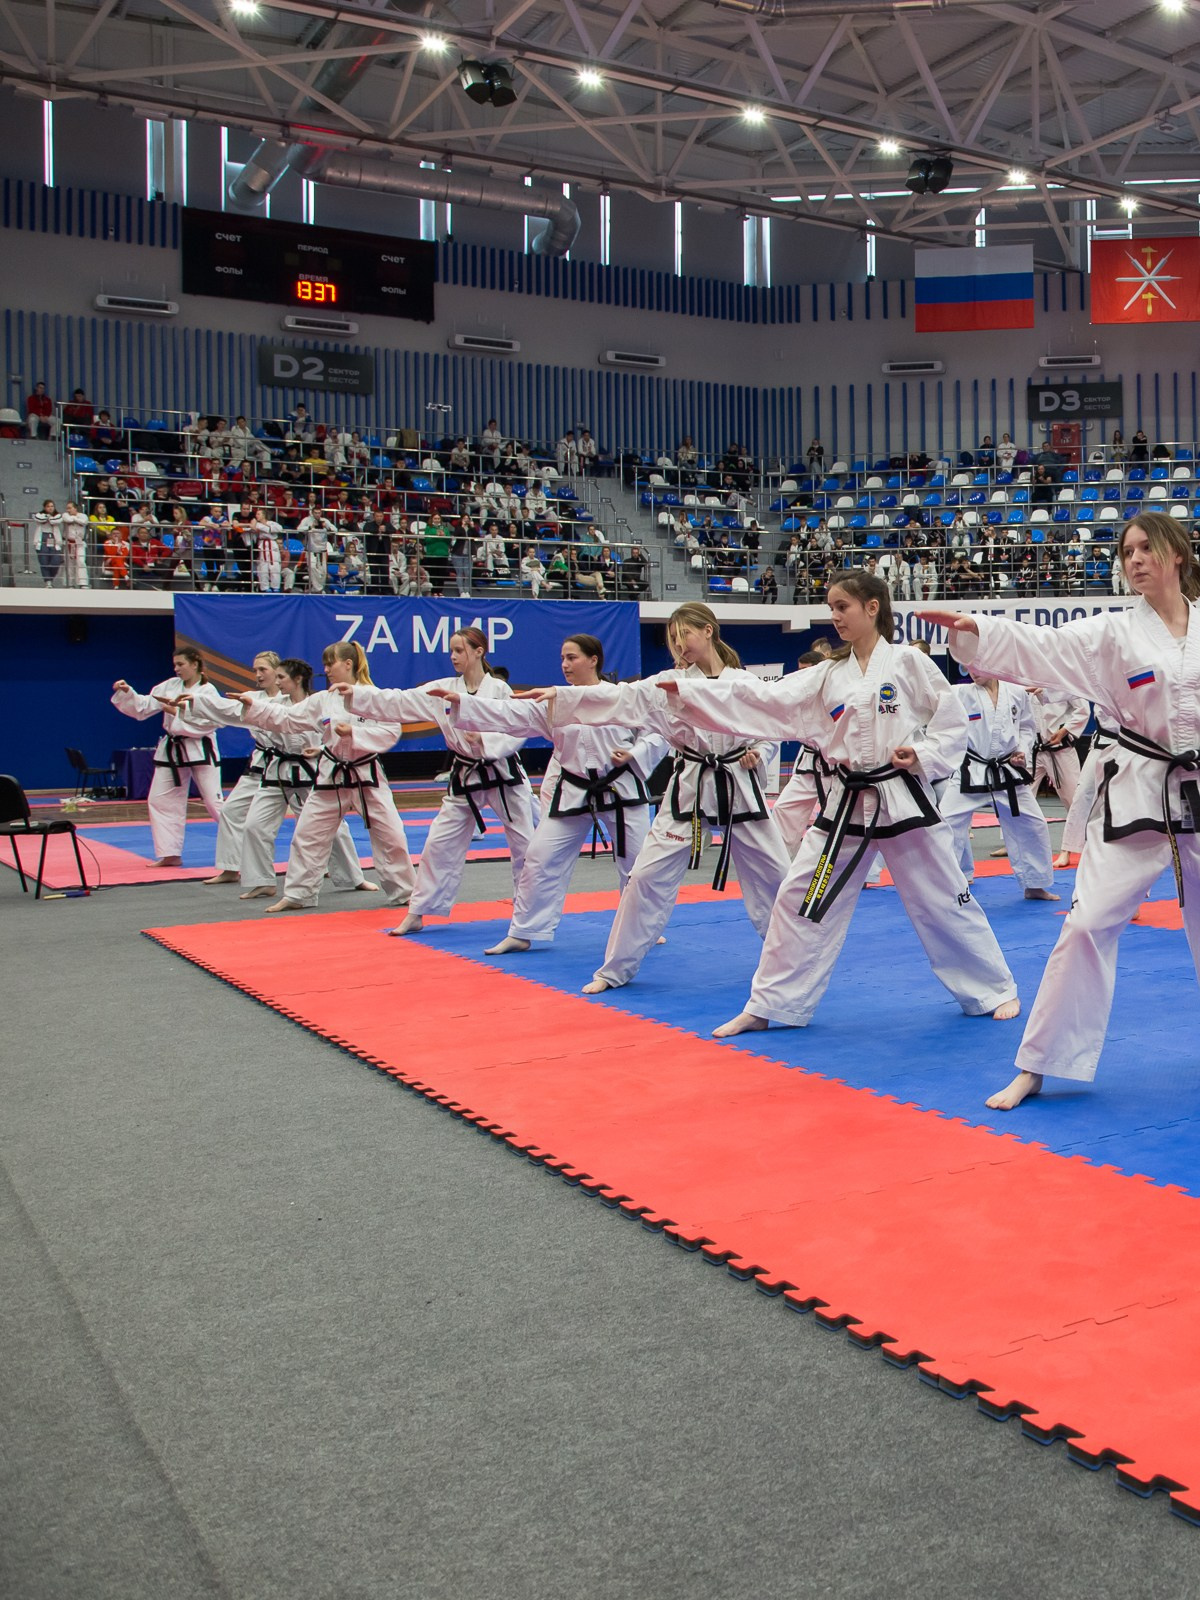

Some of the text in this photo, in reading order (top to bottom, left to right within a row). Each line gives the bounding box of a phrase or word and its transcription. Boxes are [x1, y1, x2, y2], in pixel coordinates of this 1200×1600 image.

[297, 244, 329, 255] ПЕРИОД
[215, 265, 243, 276] ФОЛЫ
[298, 273, 329, 283] ВРЕМЯ
[381, 286, 407, 296] ФОЛЫ
[273, 353, 324, 381] D2
[328, 367, 360, 376] СЕКТОР
[1038, 390, 1081, 412] D3
